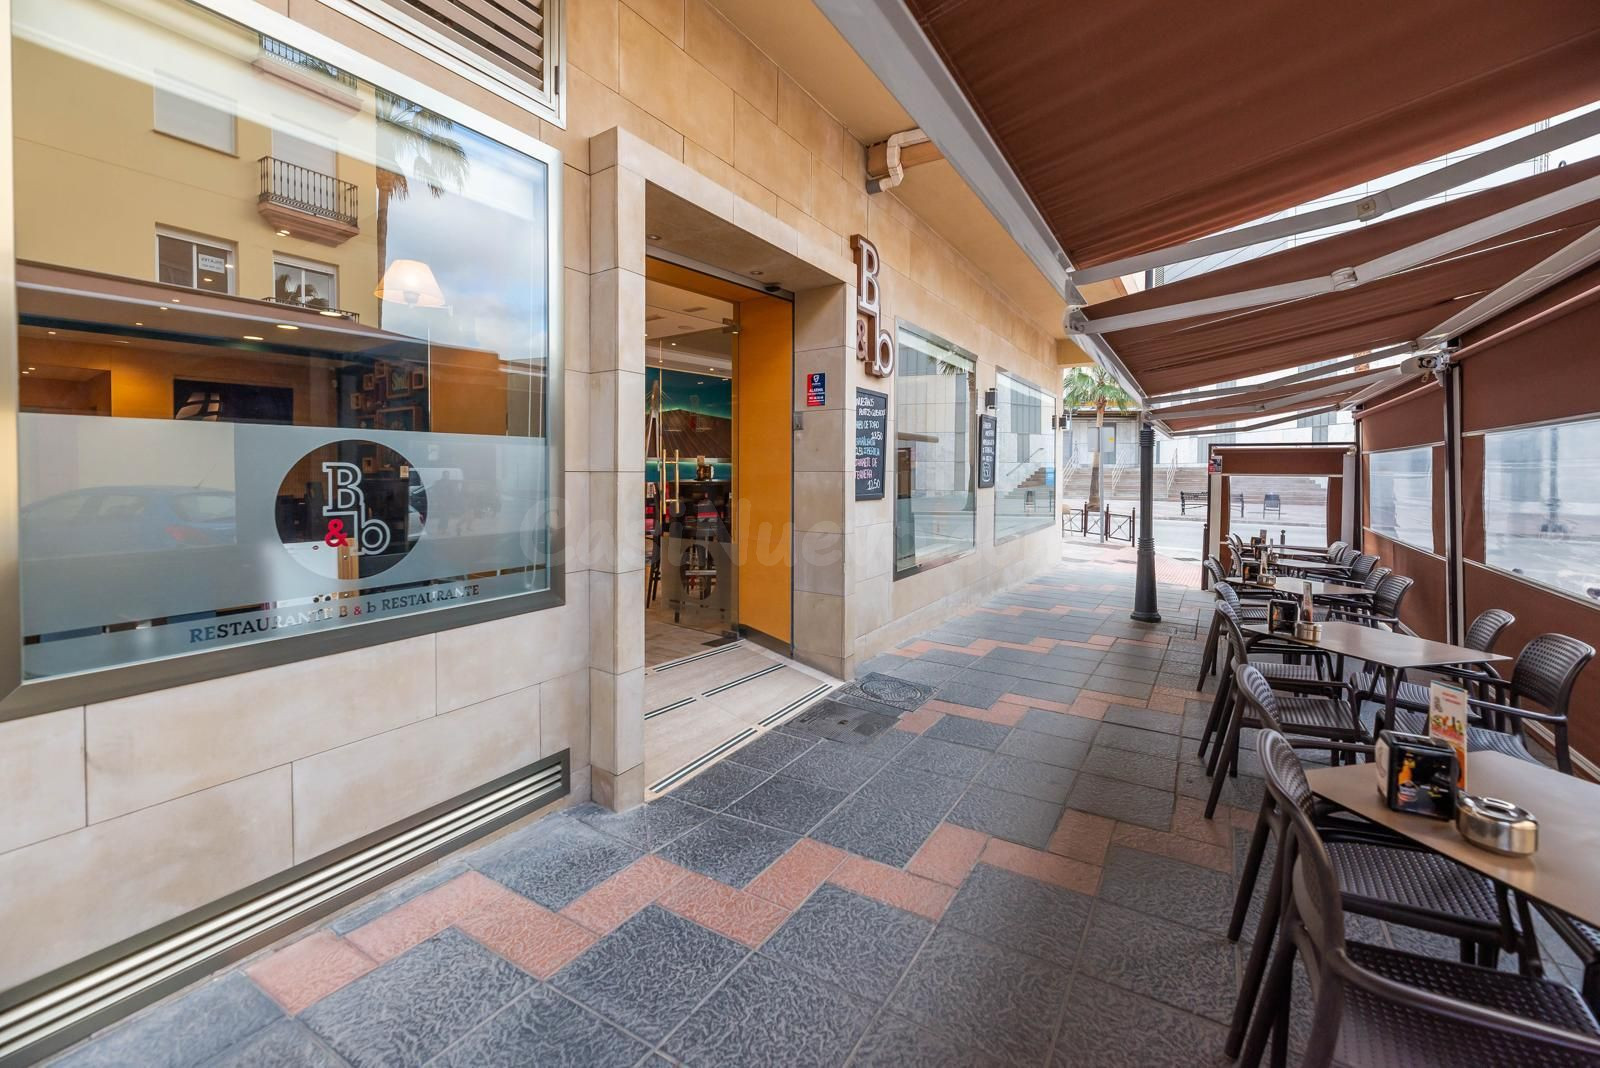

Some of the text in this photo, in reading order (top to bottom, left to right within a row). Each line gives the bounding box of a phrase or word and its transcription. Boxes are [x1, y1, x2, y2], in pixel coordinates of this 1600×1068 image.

[322, 462, 362, 516] B
[325, 518, 348, 547] &
[190, 584, 480, 644] RESTAURANTE B & b RESTAURANTE
